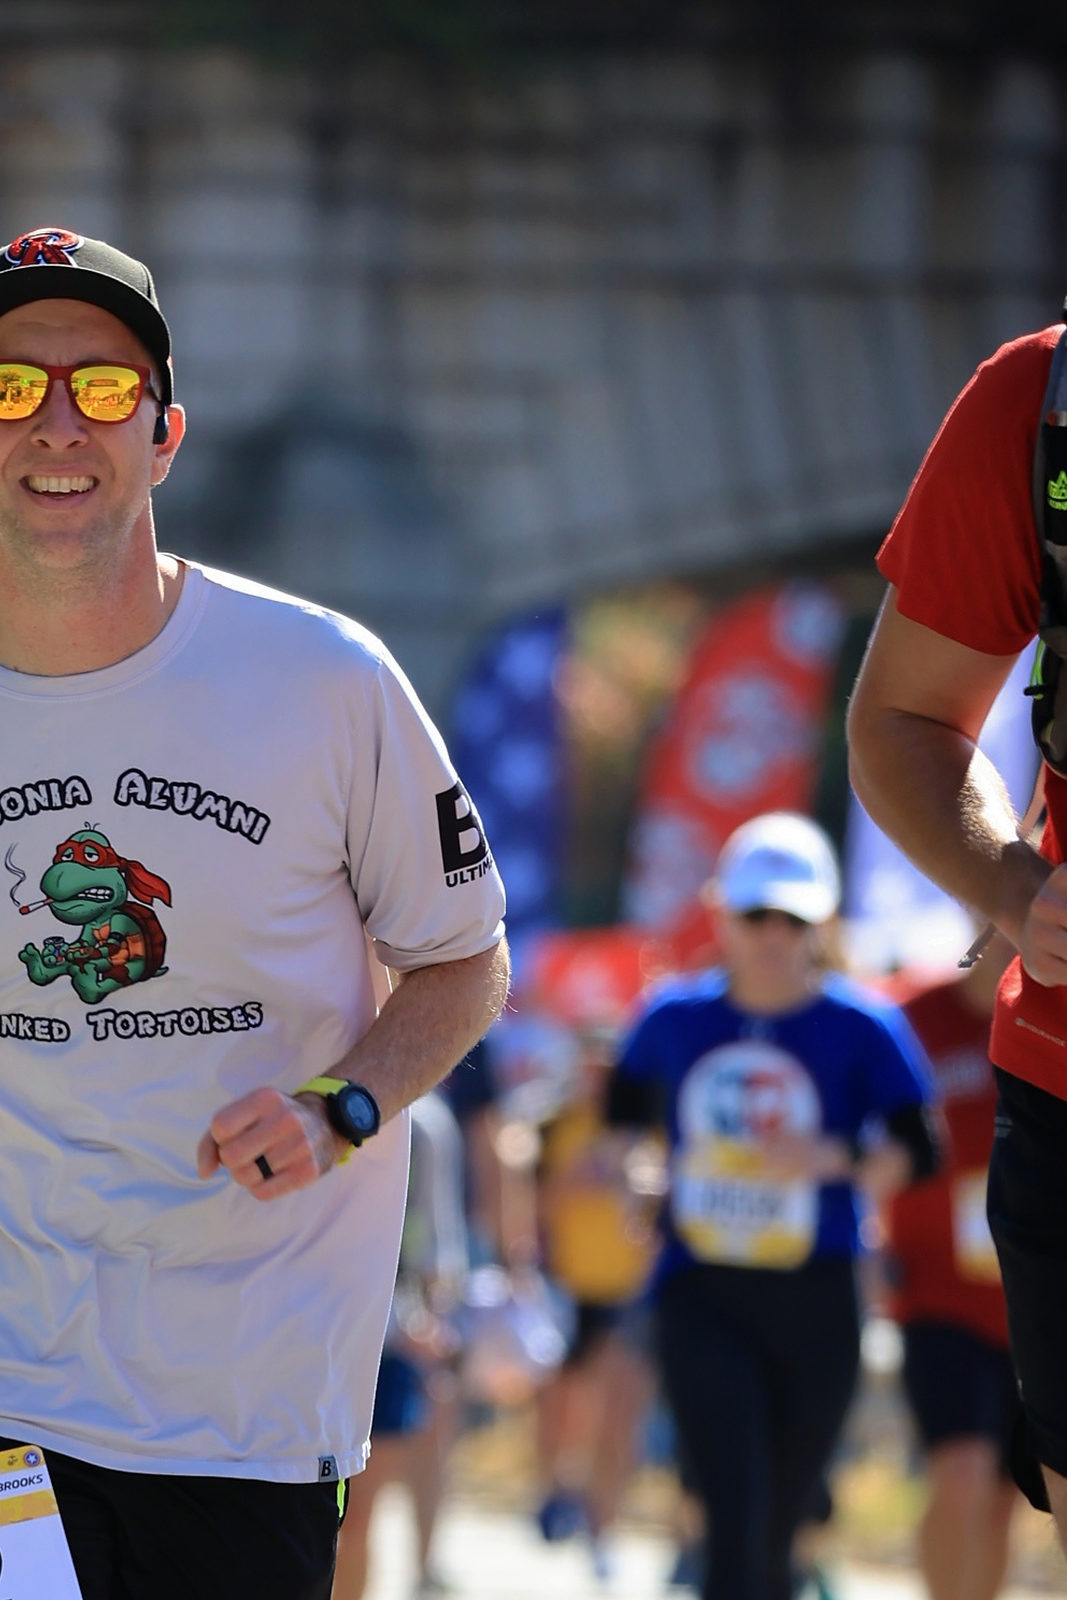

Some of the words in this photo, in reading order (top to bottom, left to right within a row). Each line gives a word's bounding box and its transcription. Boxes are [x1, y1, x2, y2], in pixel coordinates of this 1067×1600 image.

[115, 767, 271, 846] ALUMNI
[86, 1001, 263, 1042] TORTOISES
[321, 1460, 331, 1477] B
